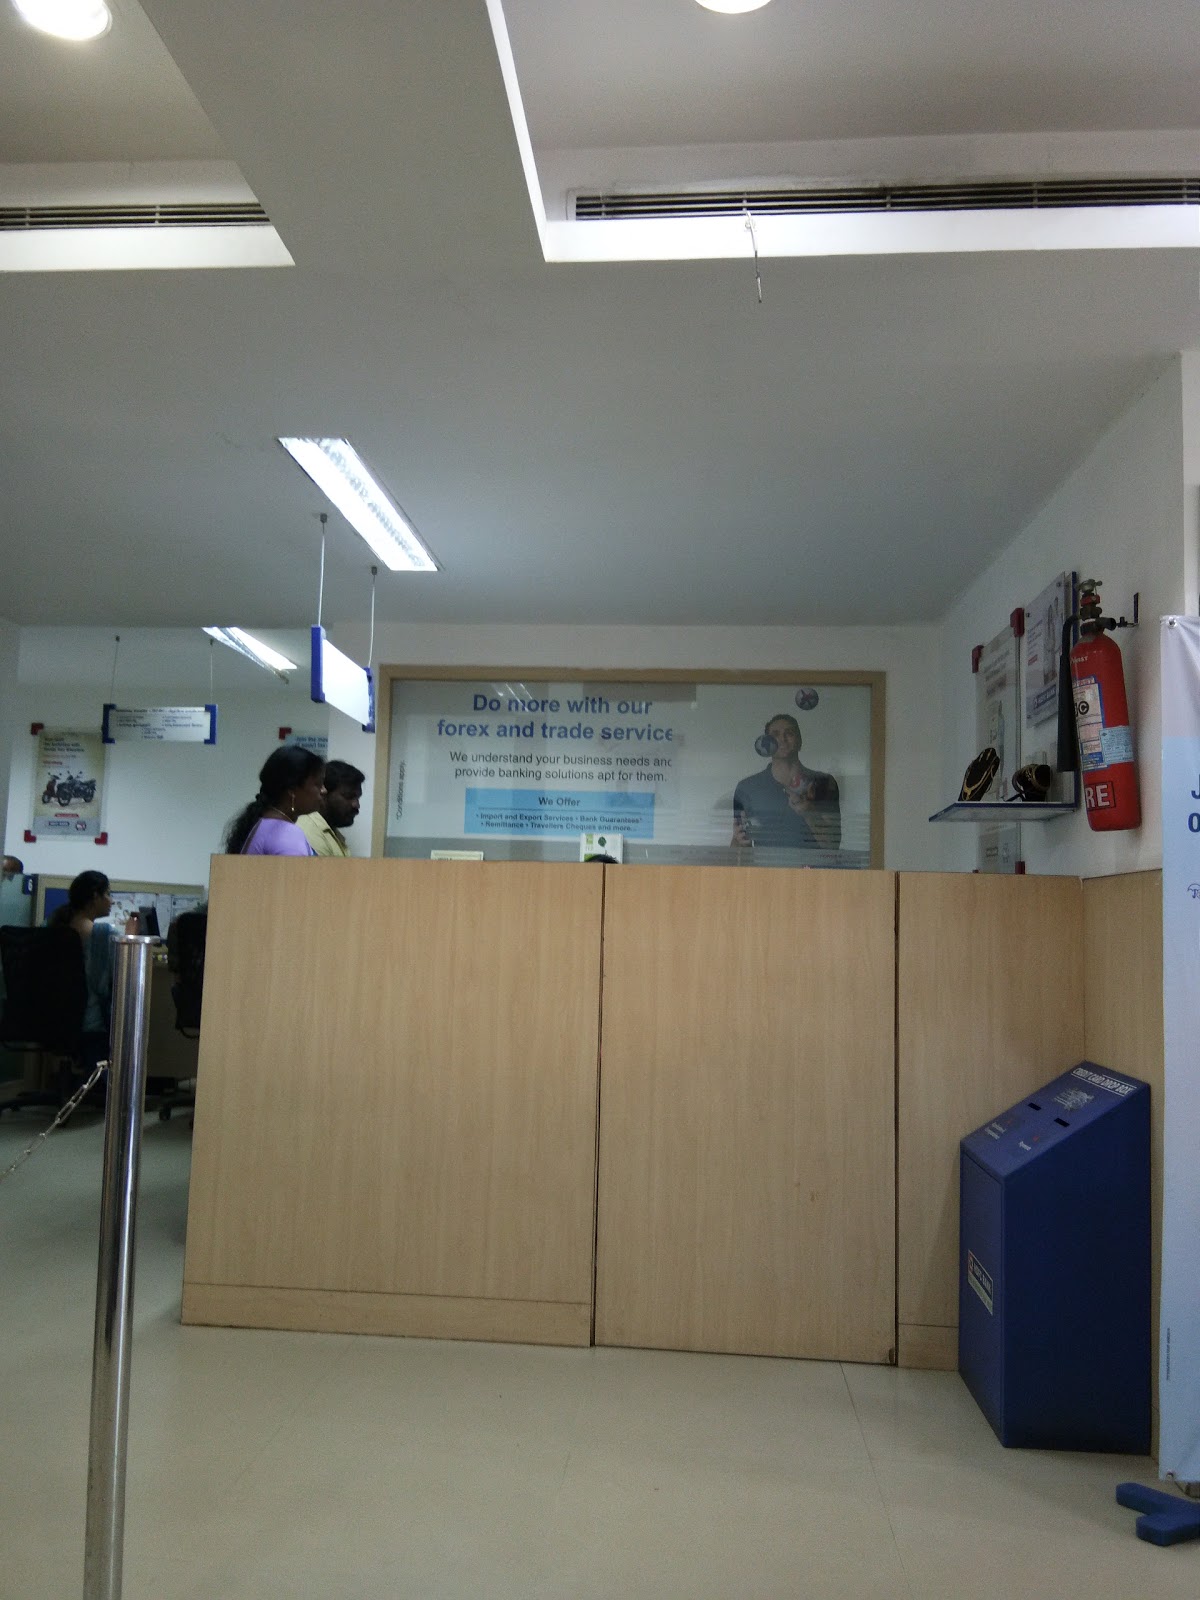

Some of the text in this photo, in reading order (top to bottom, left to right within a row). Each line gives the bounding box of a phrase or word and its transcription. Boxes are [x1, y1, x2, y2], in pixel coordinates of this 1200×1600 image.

[473, 694, 653, 714] Do more with our
[437, 719, 489, 736] forex
[496, 721, 534, 738] and
[540, 722, 595, 739] trade
[449, 750, 468, 762] We
[471, 752, 533, 764] understand
[536, 755, 561, 767] your
[563, 754, 612, 766] business
[616, 755, 650, 767] needs
[454, 766, 667, 783] provide banking solutions apt for them.
[538, 796, 581, 807] We Offer
[480, 813, 503, 822] Import
[505, 813, 518, 821] and
[519, 813, 542, 823] Export
[544, 814, 573, 822] Services
[580, 815, 598, 823] Bank
[485, 821, 524, 829] Remittance
[531, 822, 564, 830] Travellers
[566, 823, 595, 832] Cheques
